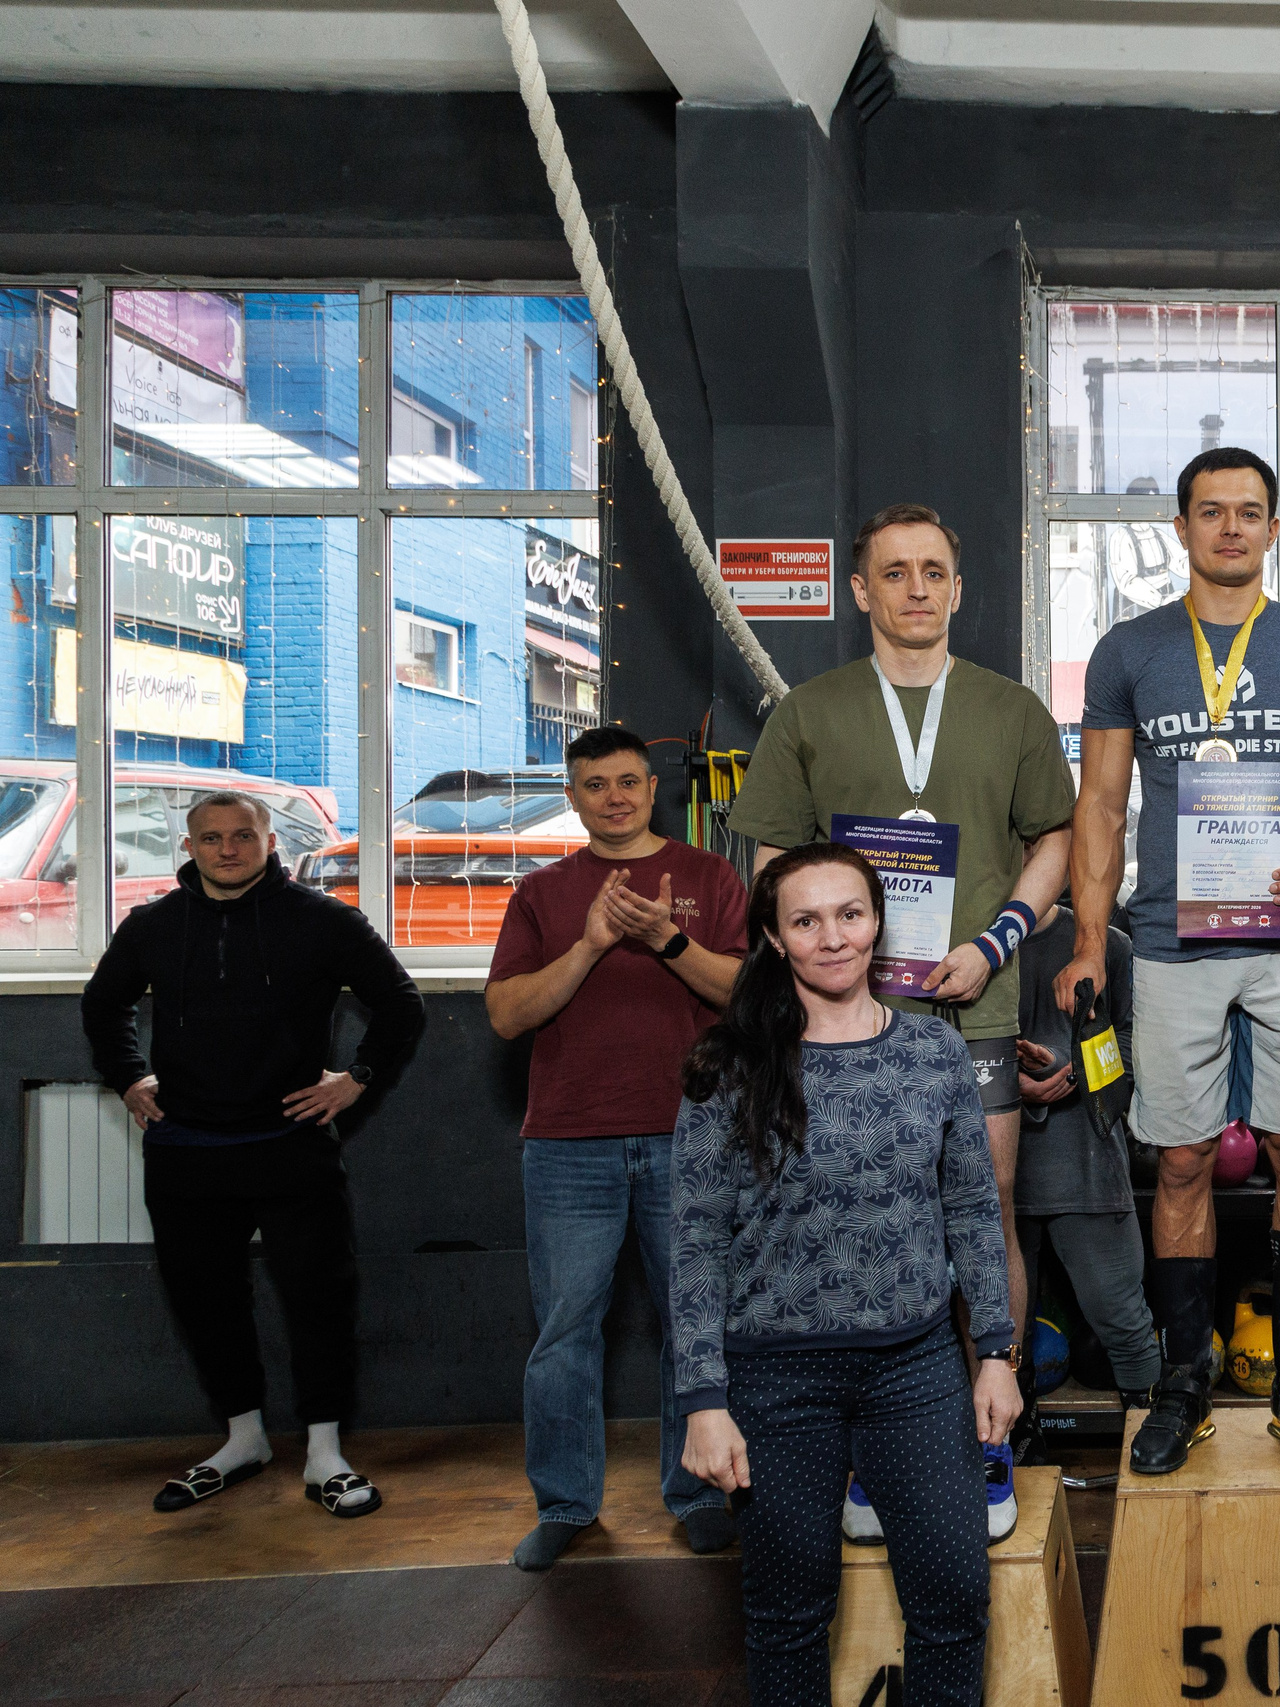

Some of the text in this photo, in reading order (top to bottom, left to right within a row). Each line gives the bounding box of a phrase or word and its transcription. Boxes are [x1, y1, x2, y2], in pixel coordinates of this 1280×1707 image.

[125, 365, 182, 406] Voice lab
[147, 516, 222, 550] КЛУБ ДРУЗЕЙ
[113, 526, 234, 586] САПФИР
[722, 552, 828, 564] ЗАКОНЧИЛ ТРЕНИРОВКУ
[722, 567, 828, 576] ПРОТРИ И УБЕРИ ОБОРУДОВАНИЕ
[195, 593, 218, 608] ОФИС
[196, 604, 216, 622] 106
[1153, 744, 1178, 758] LIFT
[1180, 741, 1198, 757] FA
[1235, 738, 1260, 753] DIE
[1201, 793, 1279, 803] ОТКРЫТЫЙ ТУРНИР
[1206, 802, 1245, 811] ТЯЖЕЛОЙ
[853, 825, 936, 837] ФЕДЕРАЦИЯ ФУНКЦИОНАЛЬНОГО
[1197, 820, 1280, 835] ГРАМОТА
[845, 831, 879, 839] МНОГОБОРЬЯ
[879, 834, 919, 843] СВЕРДЛОВСКОЙ
[1210, 838, 1269, 846] НАГРАЖДАЕТСЯ
[900, 852, 933, 862] ТУРНИР
[868, 858, 940, 872] ЖЕЛОЙ АТЛЕТИКЕ
[883, 876, 933, 894] МОТА
[884, 894, 919, 903] ЖДАЕТСЯ
[1237, 1360, 1247, 1374] 16
[1040, 1418, 1076, 1429] БОРНЫЕ
